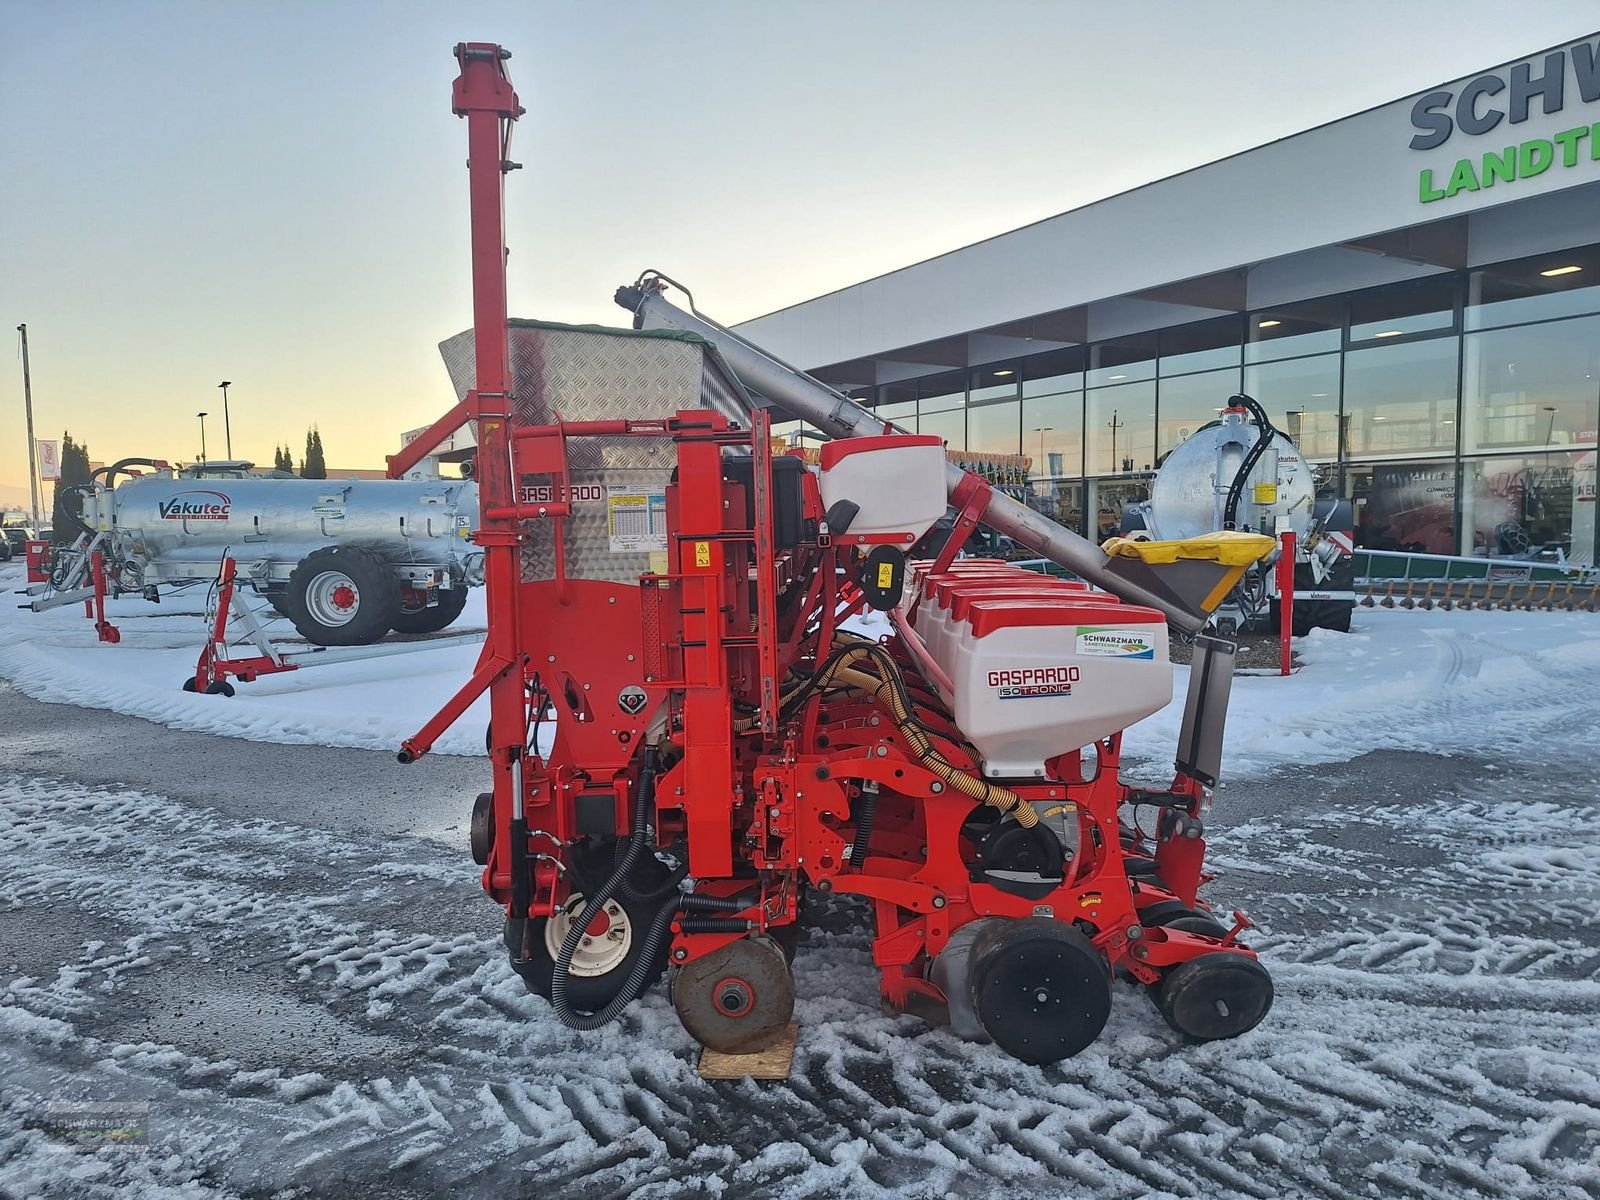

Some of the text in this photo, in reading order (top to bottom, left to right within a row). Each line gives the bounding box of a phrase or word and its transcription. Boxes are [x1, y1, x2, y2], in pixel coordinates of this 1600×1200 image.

[521, 486, 601, 501] GASRDO
[159, 498, 231, 519] Vakutec
[1084, 635, 1143, 645] SCHWARZMAYR
[988, 667, 1080, 687] GASPARDO
[1000, 684, 1072, 696] ISOTRONIC
